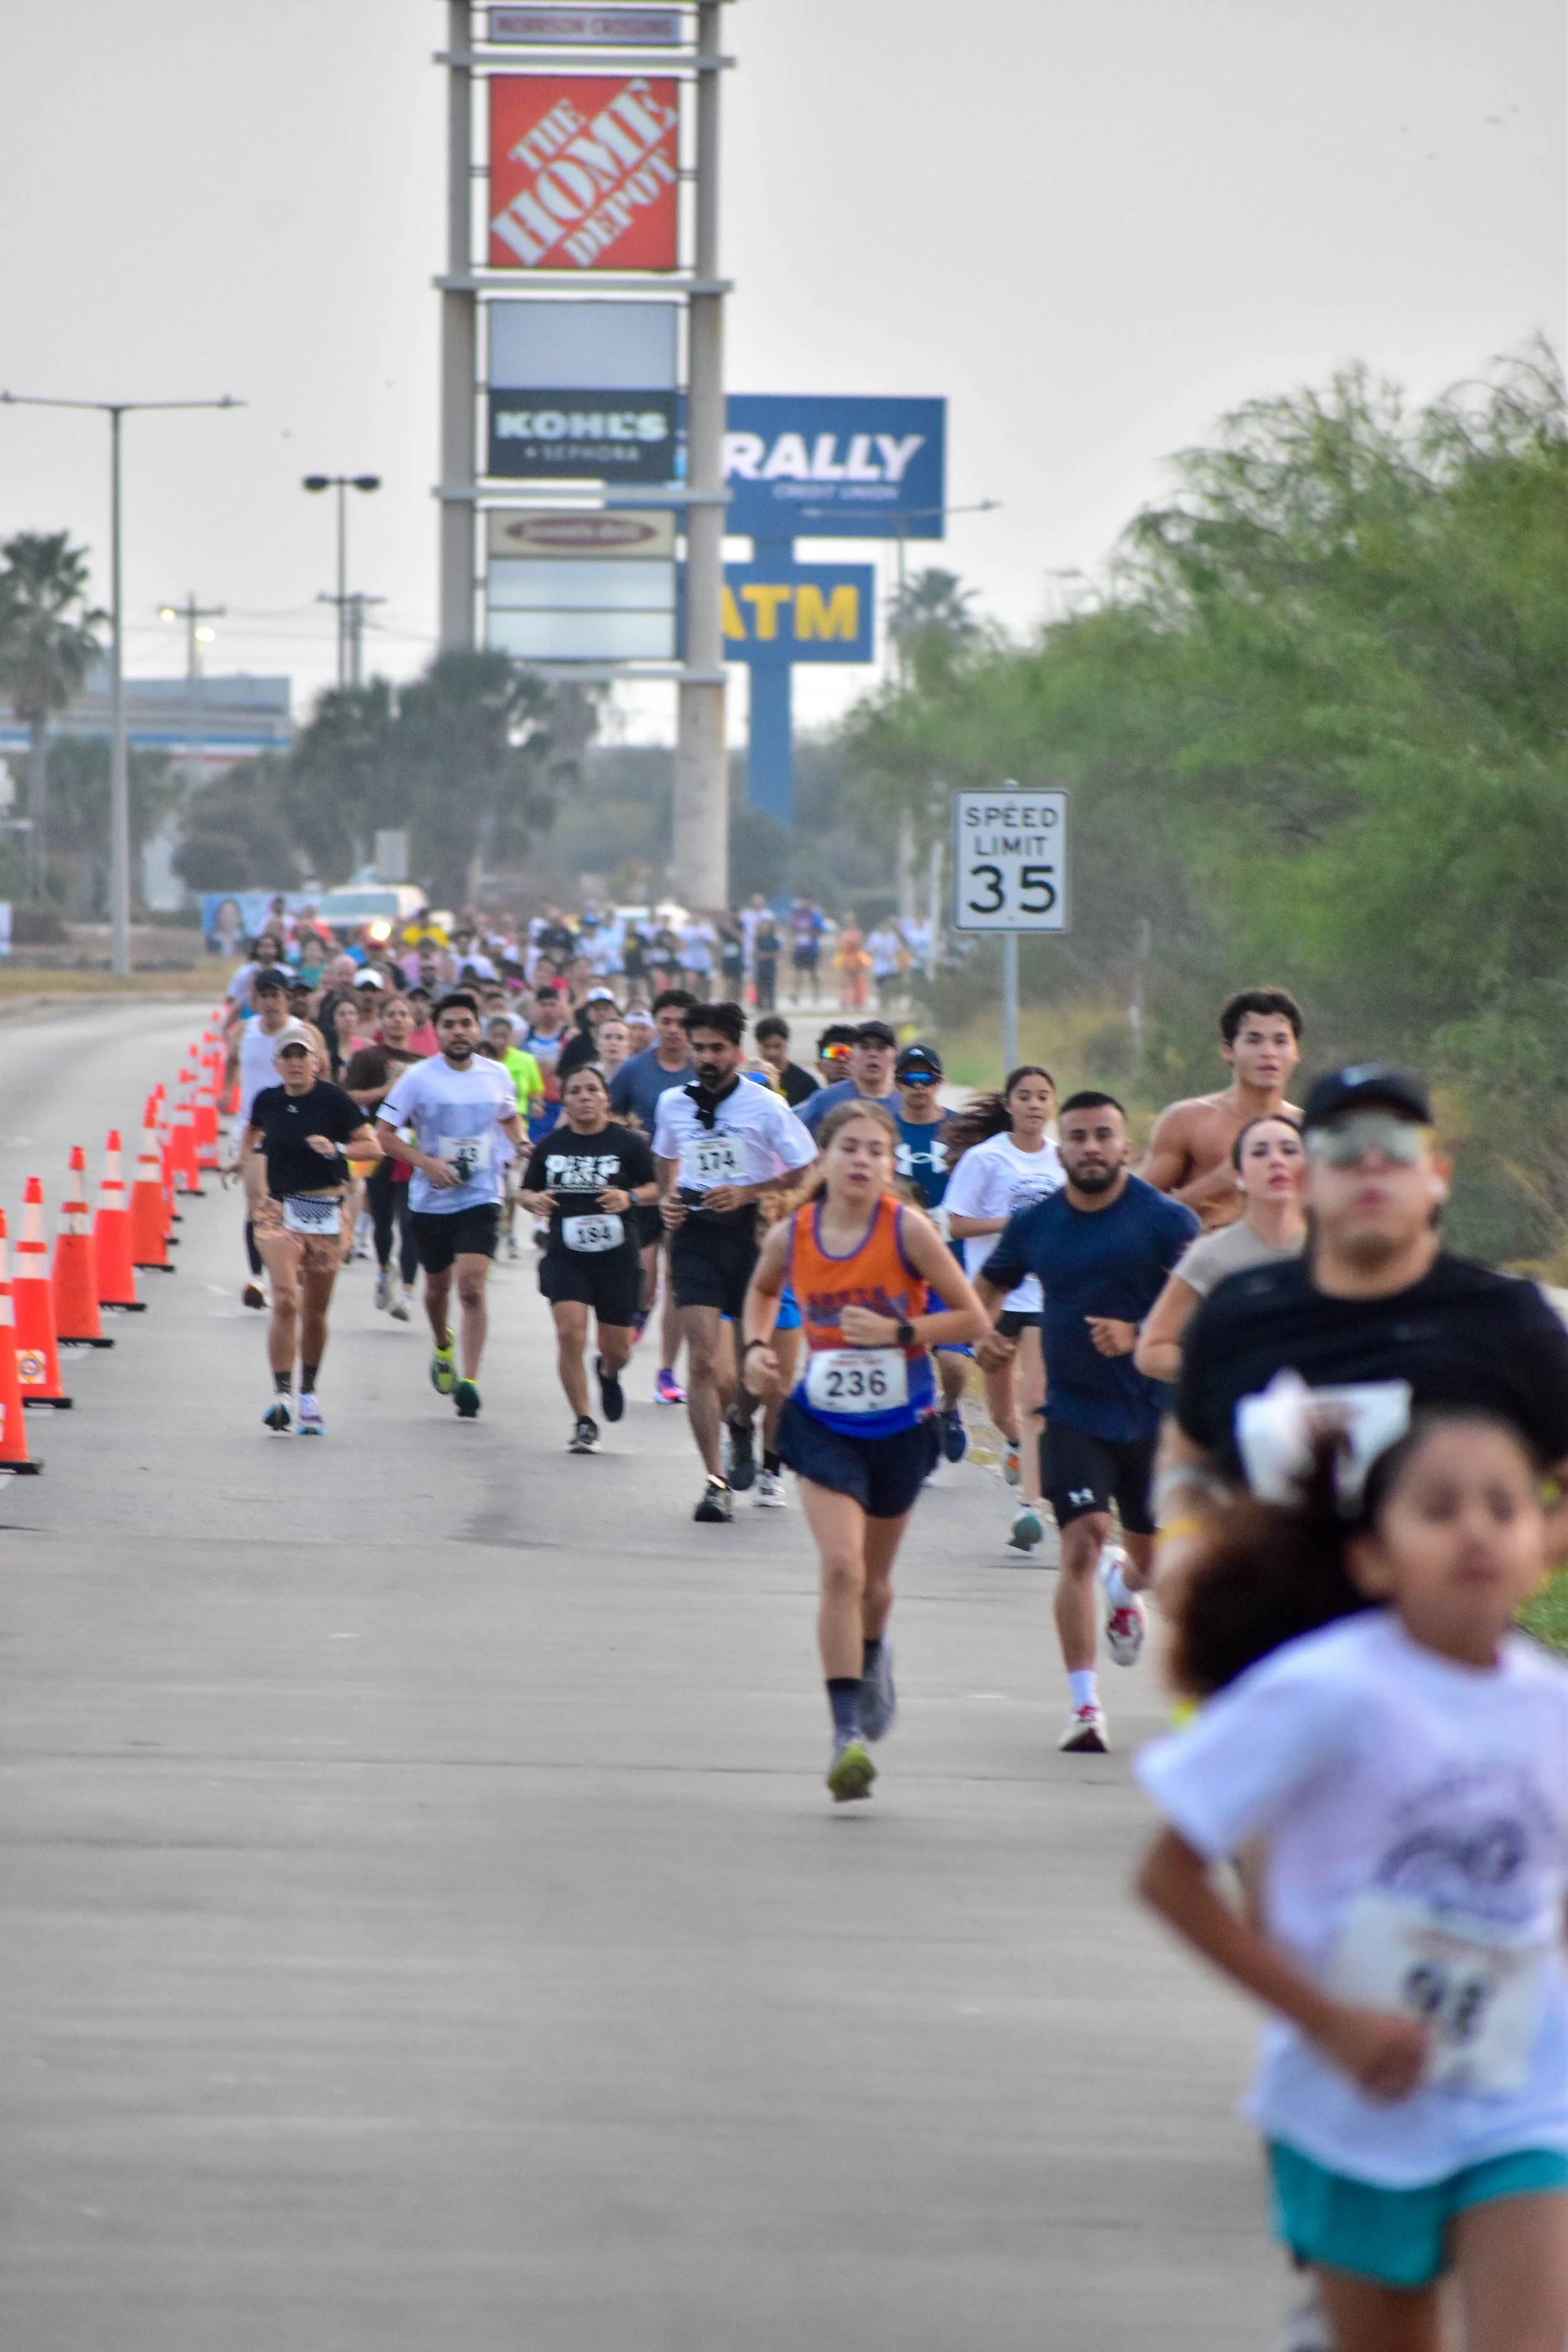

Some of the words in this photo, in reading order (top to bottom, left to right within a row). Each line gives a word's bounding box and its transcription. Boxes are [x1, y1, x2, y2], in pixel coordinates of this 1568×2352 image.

[507, 98, 586, 171] THE
[491, 78, 678, 268] HOME
[563, 148, 677, 268] DEPOT
[495, 411, 668, 442] KOHL'S
[721, 432, 925, 481] RALLY
[965, 807, 1059, 828] SPEED
[974, 835, 1049, 857] LIMIT
[968, 864, 1057, 914] 35
[697, 1150, 736, 1171] 174
[827, 1370, 887, 1397] 236
